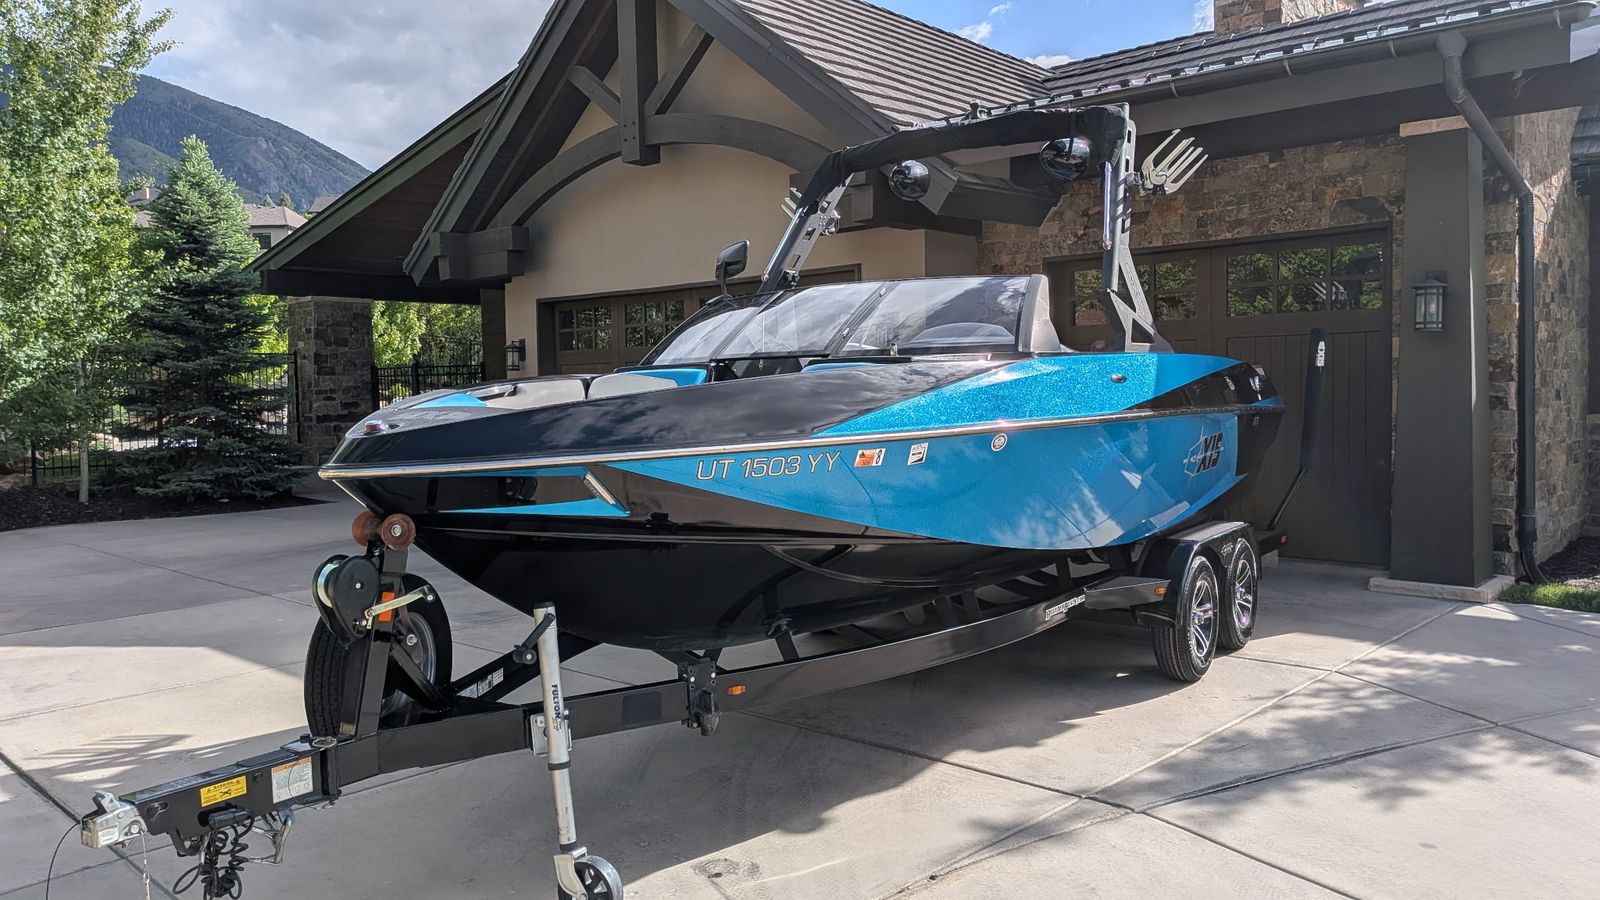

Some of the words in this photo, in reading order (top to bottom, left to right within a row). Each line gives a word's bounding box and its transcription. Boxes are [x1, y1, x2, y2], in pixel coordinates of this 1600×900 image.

[696, 459, 735, 480] UT
[741, 455, 801, 478] 1503
[808, 451, 841, 473] YY
[551, 684, 561, 720] FULTON
